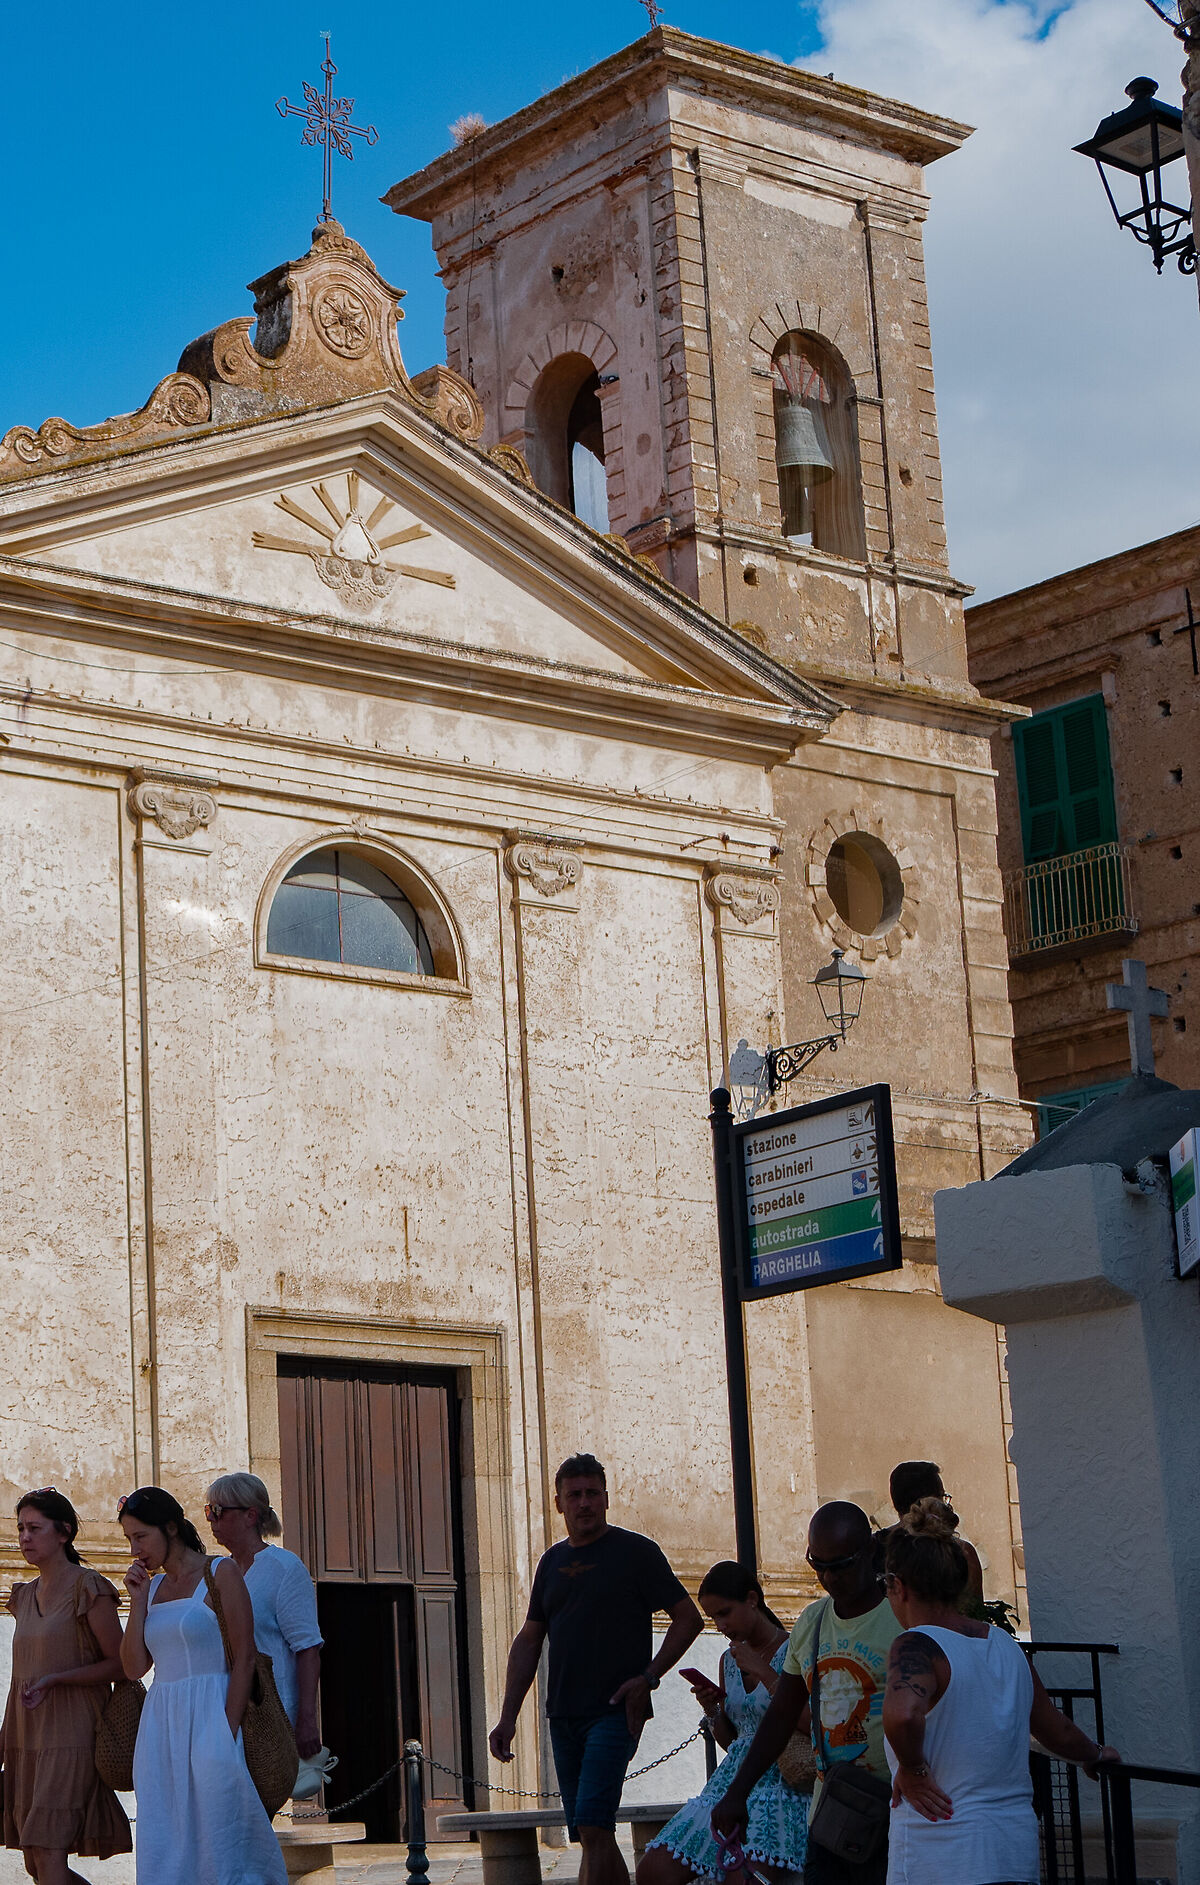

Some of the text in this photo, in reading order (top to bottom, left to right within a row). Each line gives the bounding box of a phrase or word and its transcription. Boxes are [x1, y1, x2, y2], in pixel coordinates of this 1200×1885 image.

[746, 1131, 797, 1157] stazione
[748, 1157, 813, 1187] carabinieri
[750, 1190, 805, 1216] ospedale
[752, 1219, 820, 1249] autostrada
[753, 1250, 822, 1280] PARGHELIA
[837, 1639, 849, 1650] SO
[854, 1641, 884, 1668] HAVE
